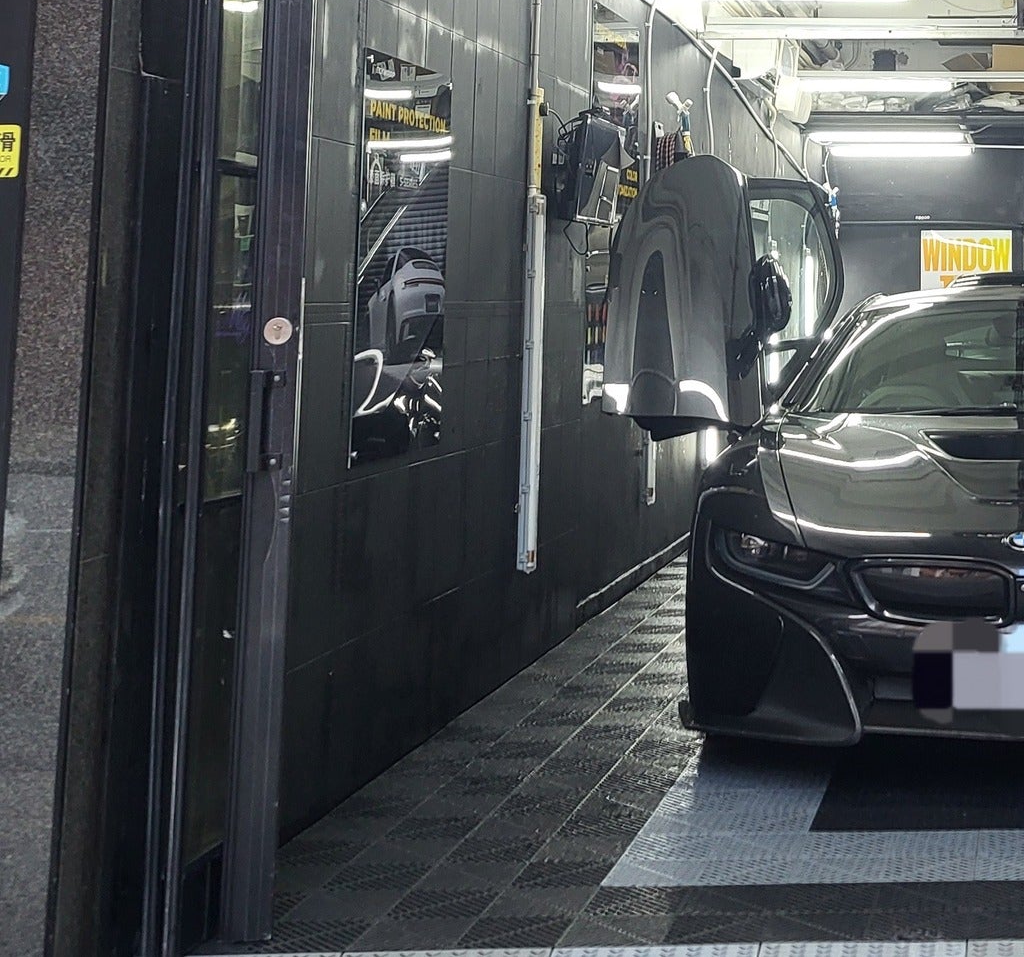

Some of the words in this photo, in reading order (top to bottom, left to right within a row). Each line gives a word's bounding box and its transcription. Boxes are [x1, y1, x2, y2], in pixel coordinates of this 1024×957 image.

[369, 99, 398, 121] PAINT
[398, 105, 447, 135] PROTECTION
[922, 237, 1011, 272] WINDOW
